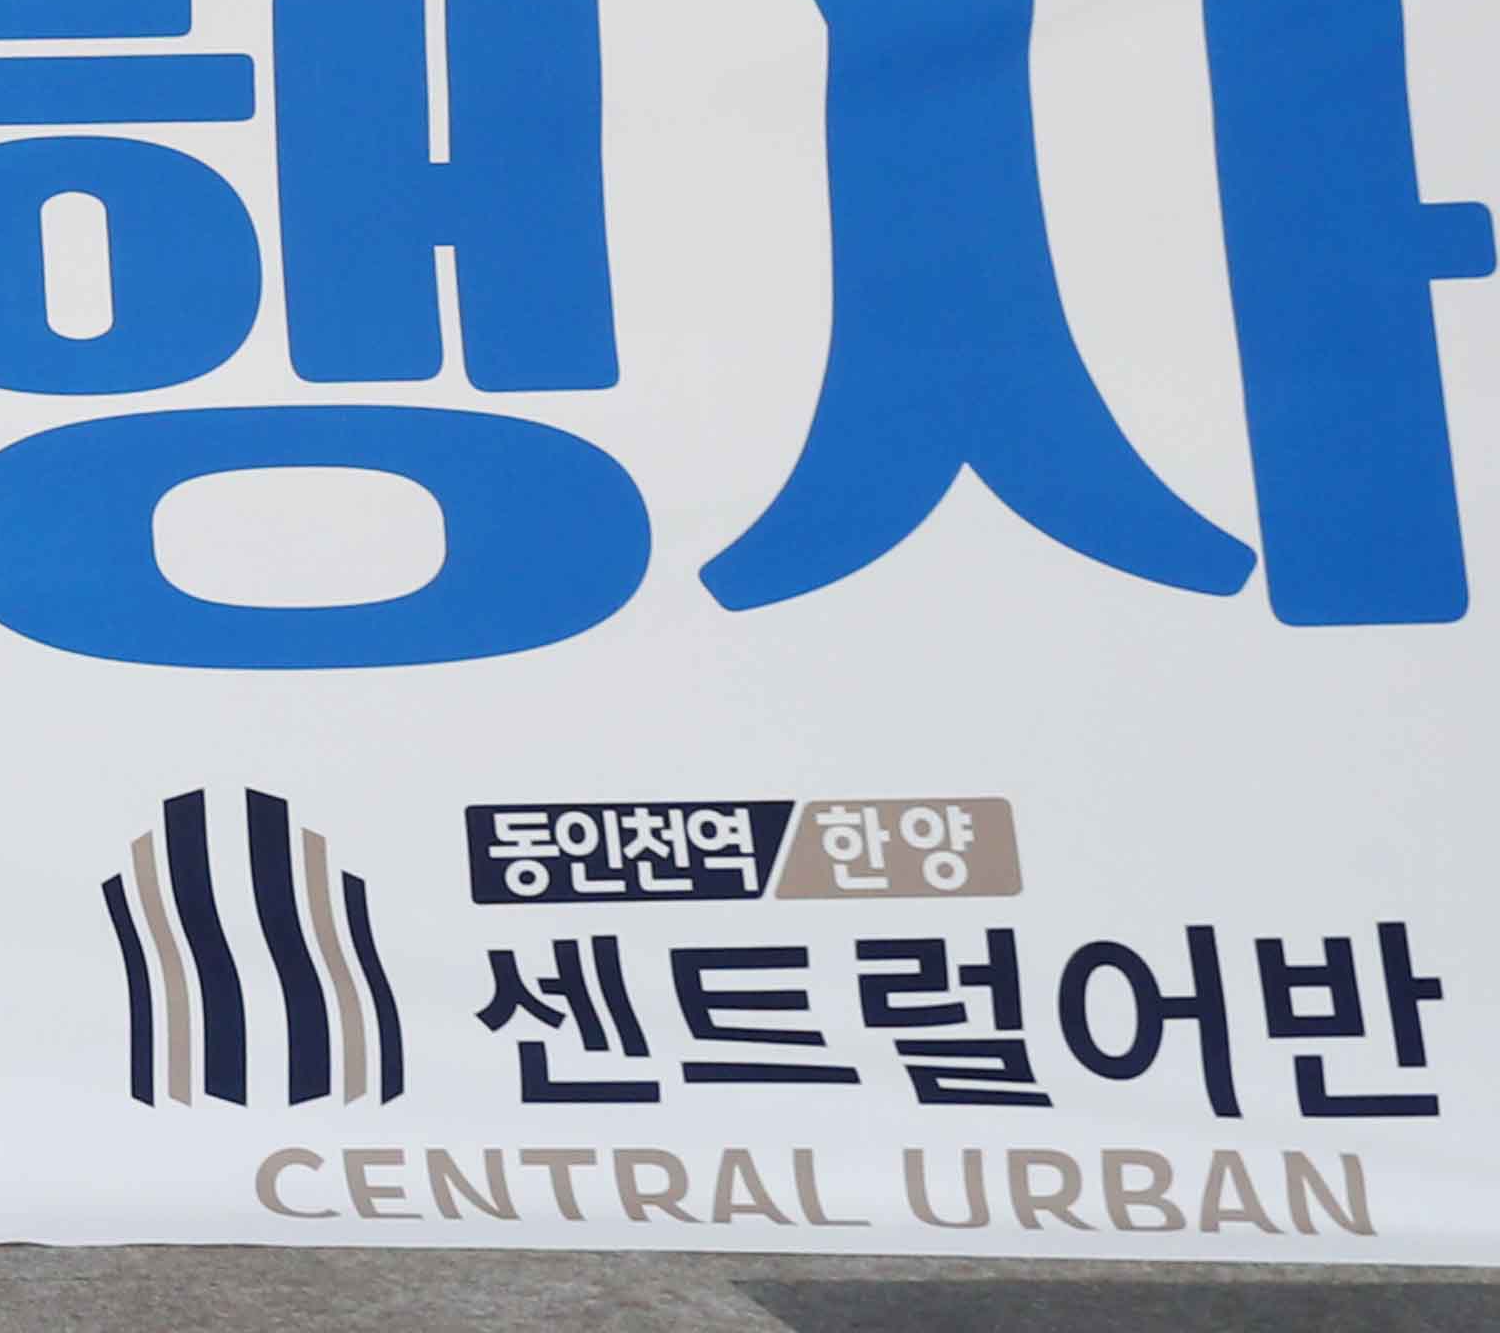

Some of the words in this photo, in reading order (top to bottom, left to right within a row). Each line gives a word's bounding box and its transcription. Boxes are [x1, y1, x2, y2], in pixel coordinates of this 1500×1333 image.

[486, 807, 761, 895] 동인천역
[815, 805, 977, 892] 한양
[475, 921, 1444, 1119] 센트럴어반
[254, 1146, 872, 1226] CENTRAL
[902, 1148, 1379, 1237] URBAN
